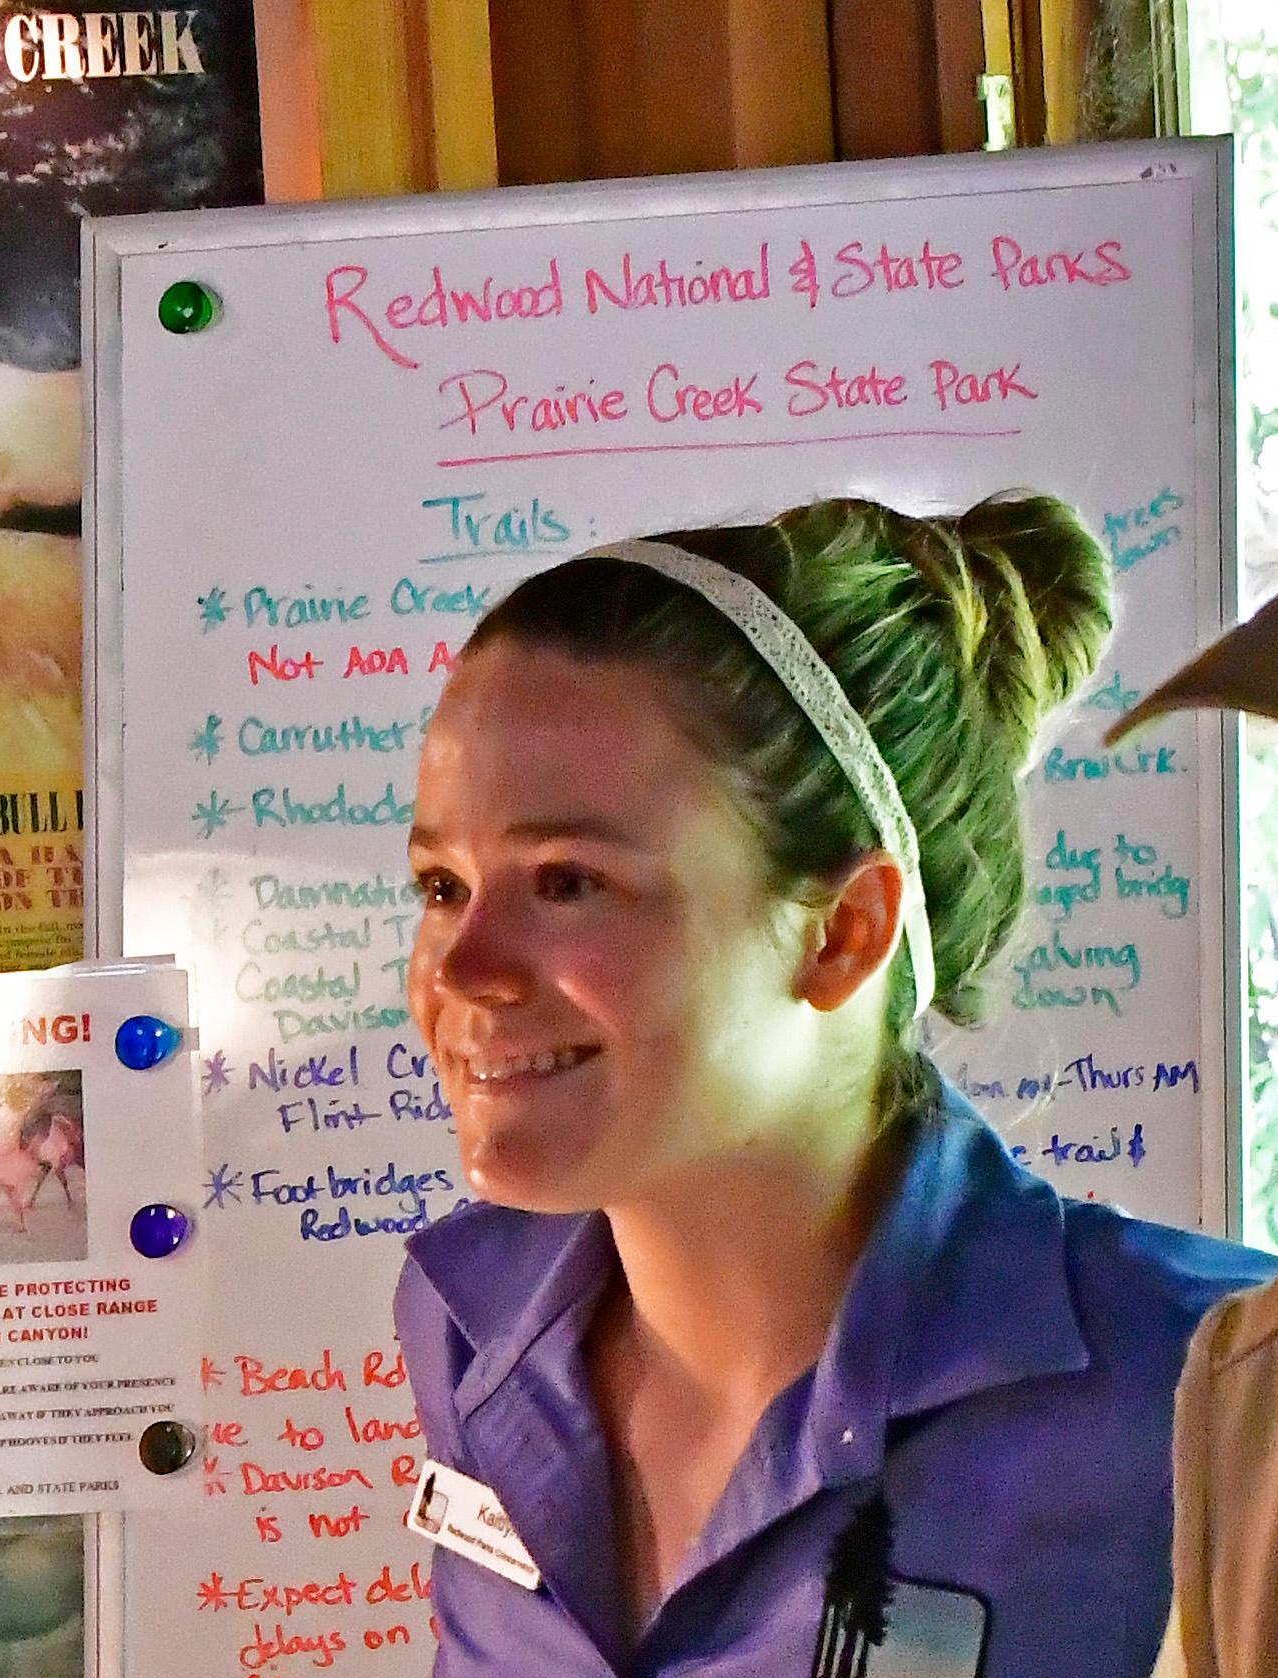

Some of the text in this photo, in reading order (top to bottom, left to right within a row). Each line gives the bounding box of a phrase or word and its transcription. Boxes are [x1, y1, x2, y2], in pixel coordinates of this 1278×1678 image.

[3, 10, 205, 81] CREEK
[324, 256, 564, 370] Redwood
[587, 241, 770, 316] National
[831, 240, 965, 298] State
[990, 235, 1133, 290] Parks
[437, 359, 1040, 436] Prairie Creek State Park
[243, 584, 372, 628] Prairie
[248, 644, 324, 686] Not
[1114, 833, 1157, 865] to
[242, 915, 373, 956] Coastal
[234, 961, 361, 1003] Coastal
[248, 1045, 359, 1093] Nickel
[1042, 1126, 1122, 1167] trail
[251, 1162, 455, 1215] Footbridges
[300, 1198, 428, 1241] Redwood
[15, 1278, 132, 1298] PROTECTING
[2, 1306, 26, 1320] AT
[31, 1302, 90, 1319] CLOSE
[97, 1299, 159, 1316] RANGE
[8, 1325, 90, 1343] CANYON!
[234, 1350, 347, 1396] Beach
[278, 1417, 324, 1451] to
[240, 1461, 373, 1495] Davison
[255, 1505, 371, 1542] is not
[237, 1571, 357, 1617] Expect
[239, 1624, 411, 1668] delays on
